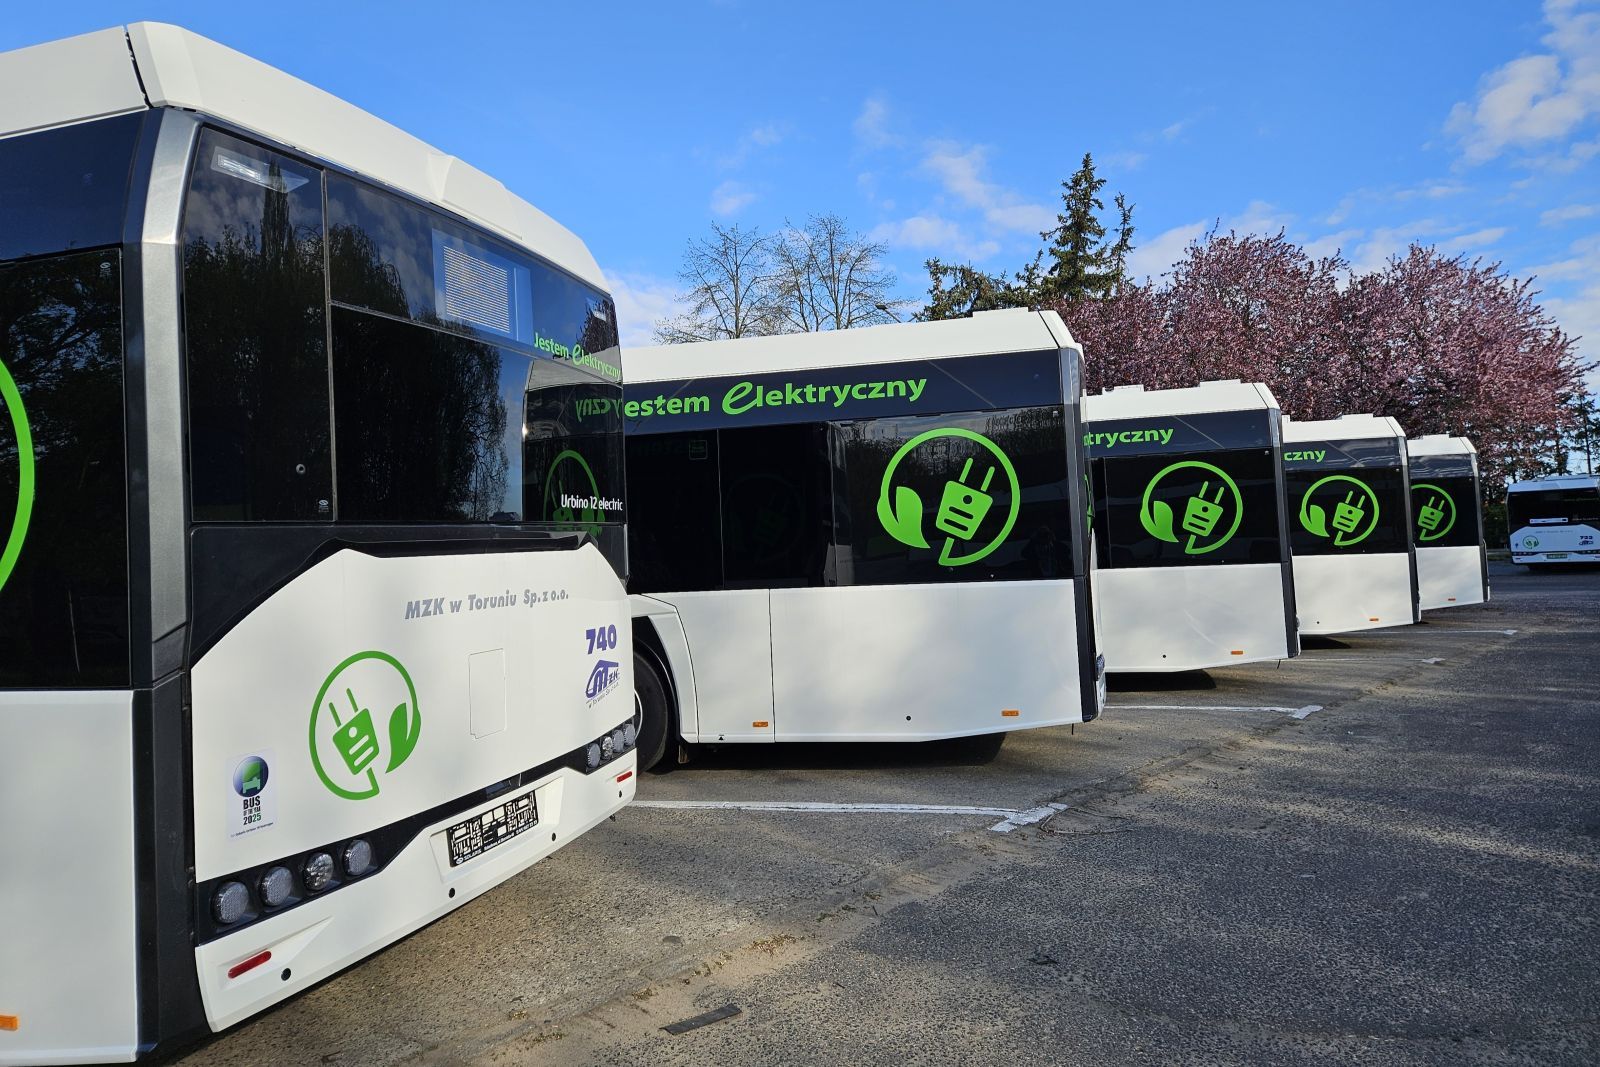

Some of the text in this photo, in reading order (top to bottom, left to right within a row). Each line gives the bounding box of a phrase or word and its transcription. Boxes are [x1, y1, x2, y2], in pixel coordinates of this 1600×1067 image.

[534, 332, 621, 382] Jestem elektryczny
[721, 378, 927, 416] elektryczny
[1283, 449, 1326, 462] czny
[561, 494, 623, 511] Urbino 12 electric
[404, 597, 445, 620] MZK
[449, 599, 462, 614] w
[467, 588, 517, 611] Toruniu
[585, 623, 617, 655] 740
[243, 795, 261, 810] BUS
[243, 812, 262, 825] 2025
